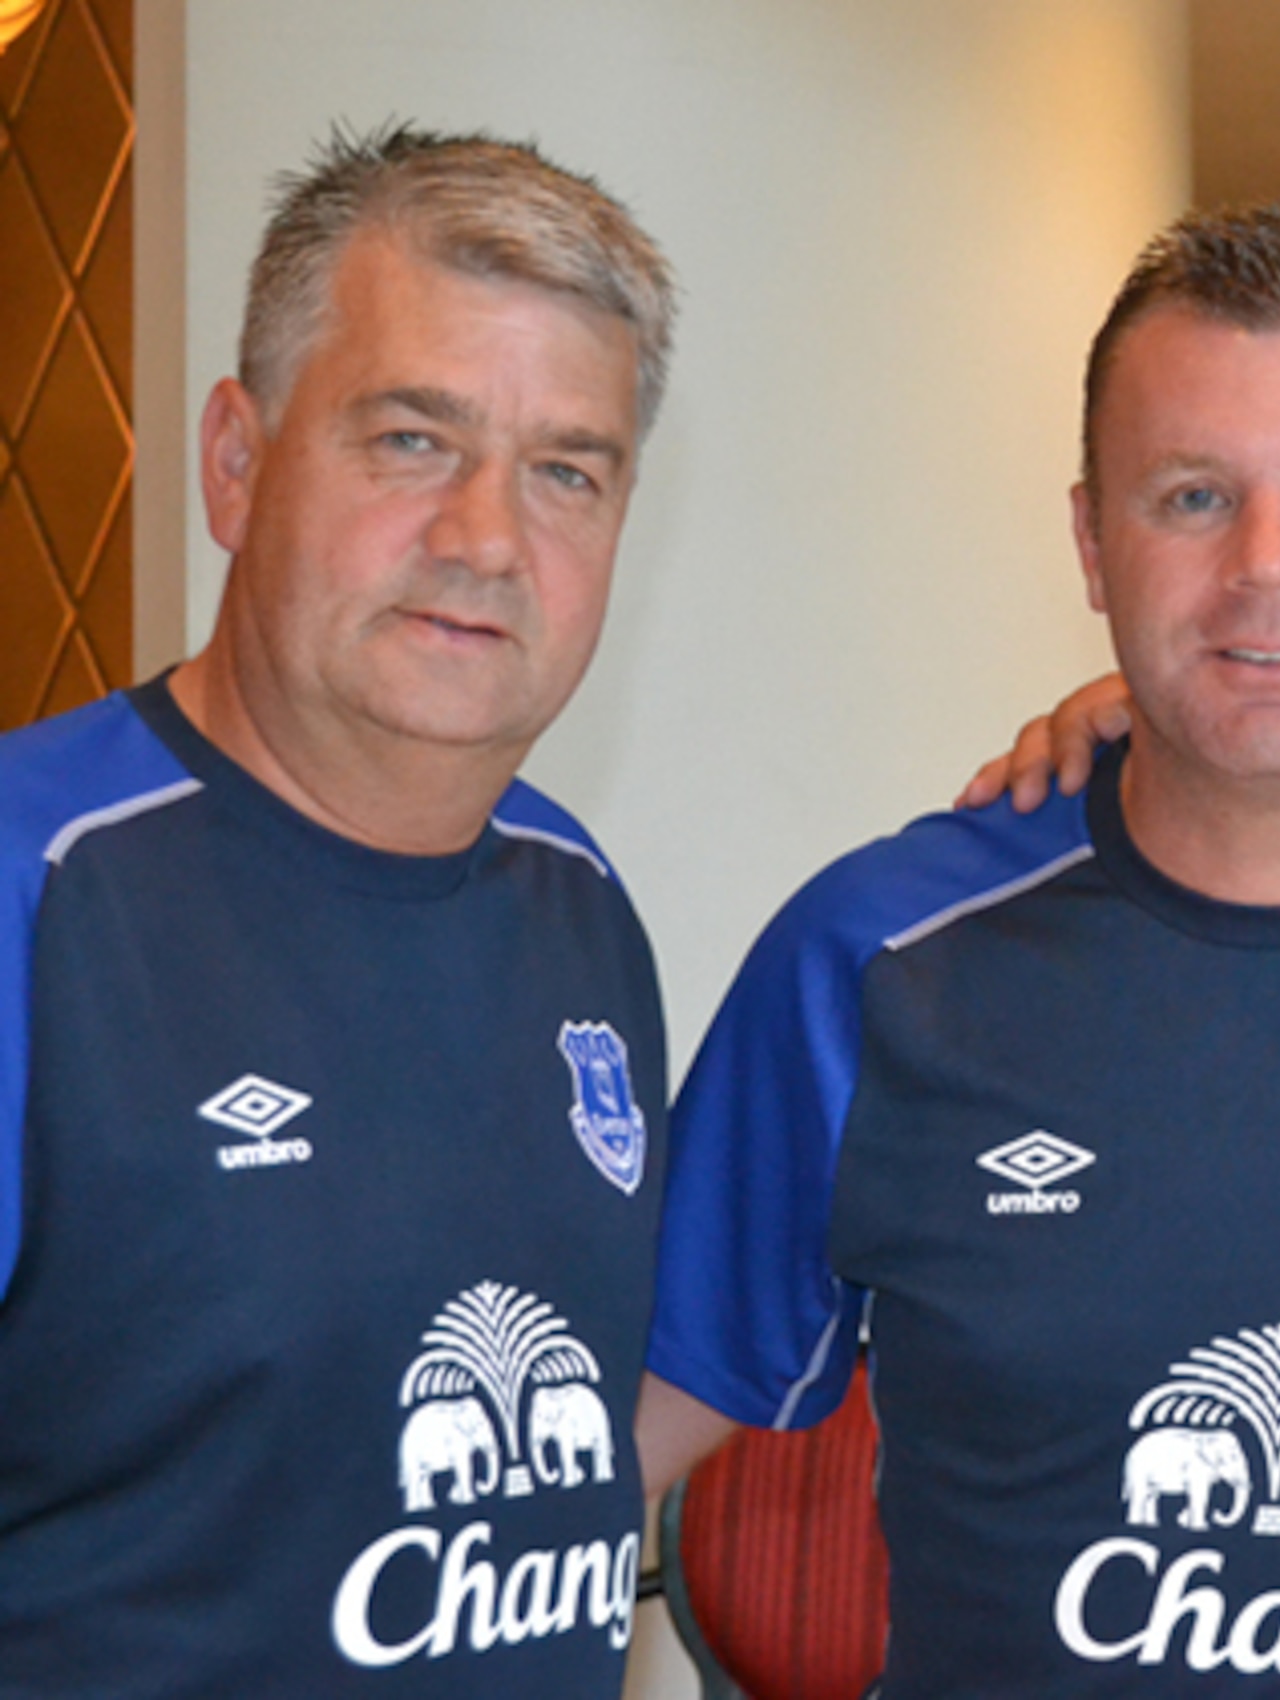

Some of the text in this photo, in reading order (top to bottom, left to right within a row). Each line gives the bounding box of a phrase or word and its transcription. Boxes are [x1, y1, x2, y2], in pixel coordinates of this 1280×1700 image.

[217, 1137, 313, 1169] umbro
[986, 1188, 1081, 1214] umbro
[332, 1521, 640, 1667] Chang
